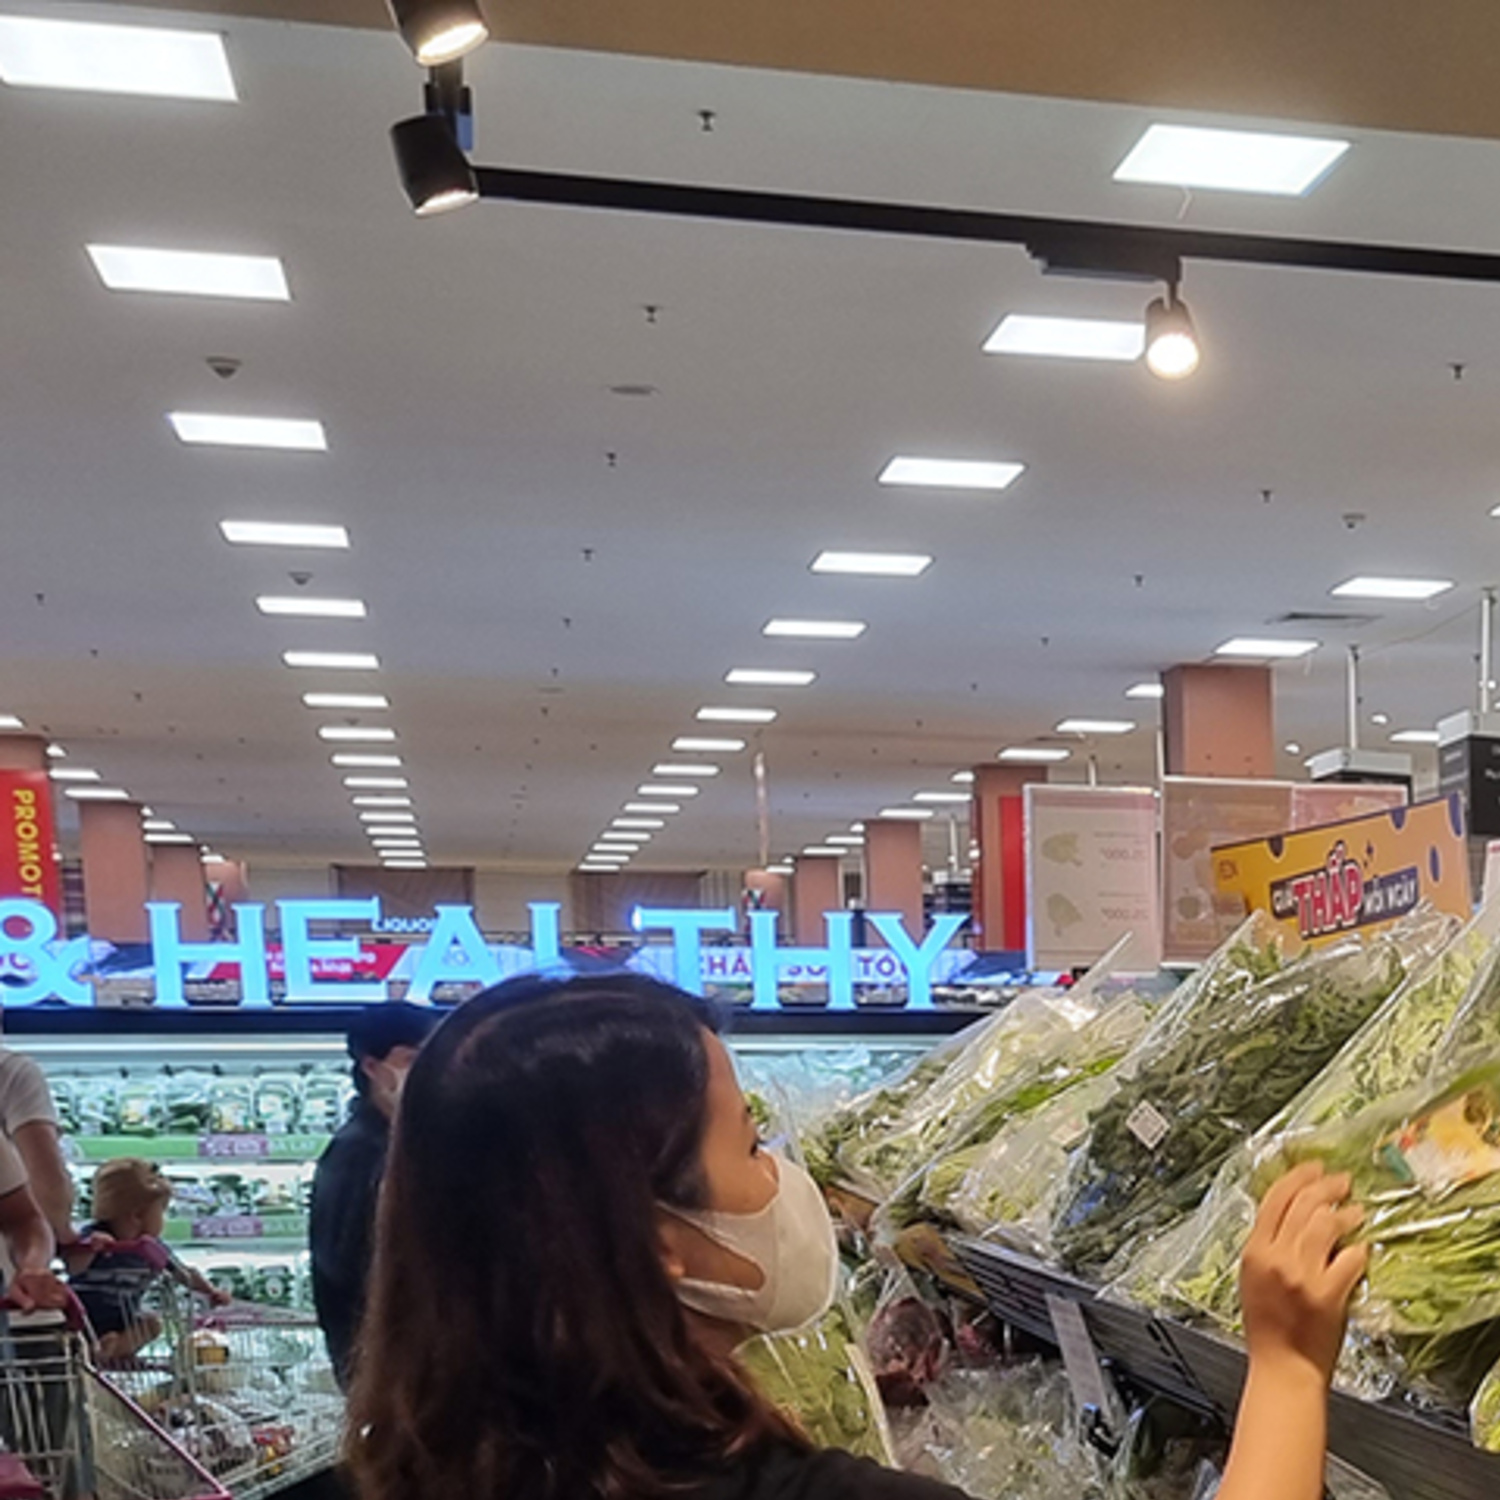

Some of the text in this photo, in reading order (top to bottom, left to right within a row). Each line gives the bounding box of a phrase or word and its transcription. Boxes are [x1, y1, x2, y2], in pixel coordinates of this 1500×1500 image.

[12, 789, 42, 895] PROMOT
[1292, 840, 1364, 939] THẤP
[372, 917, 436, 933] LIQUO
